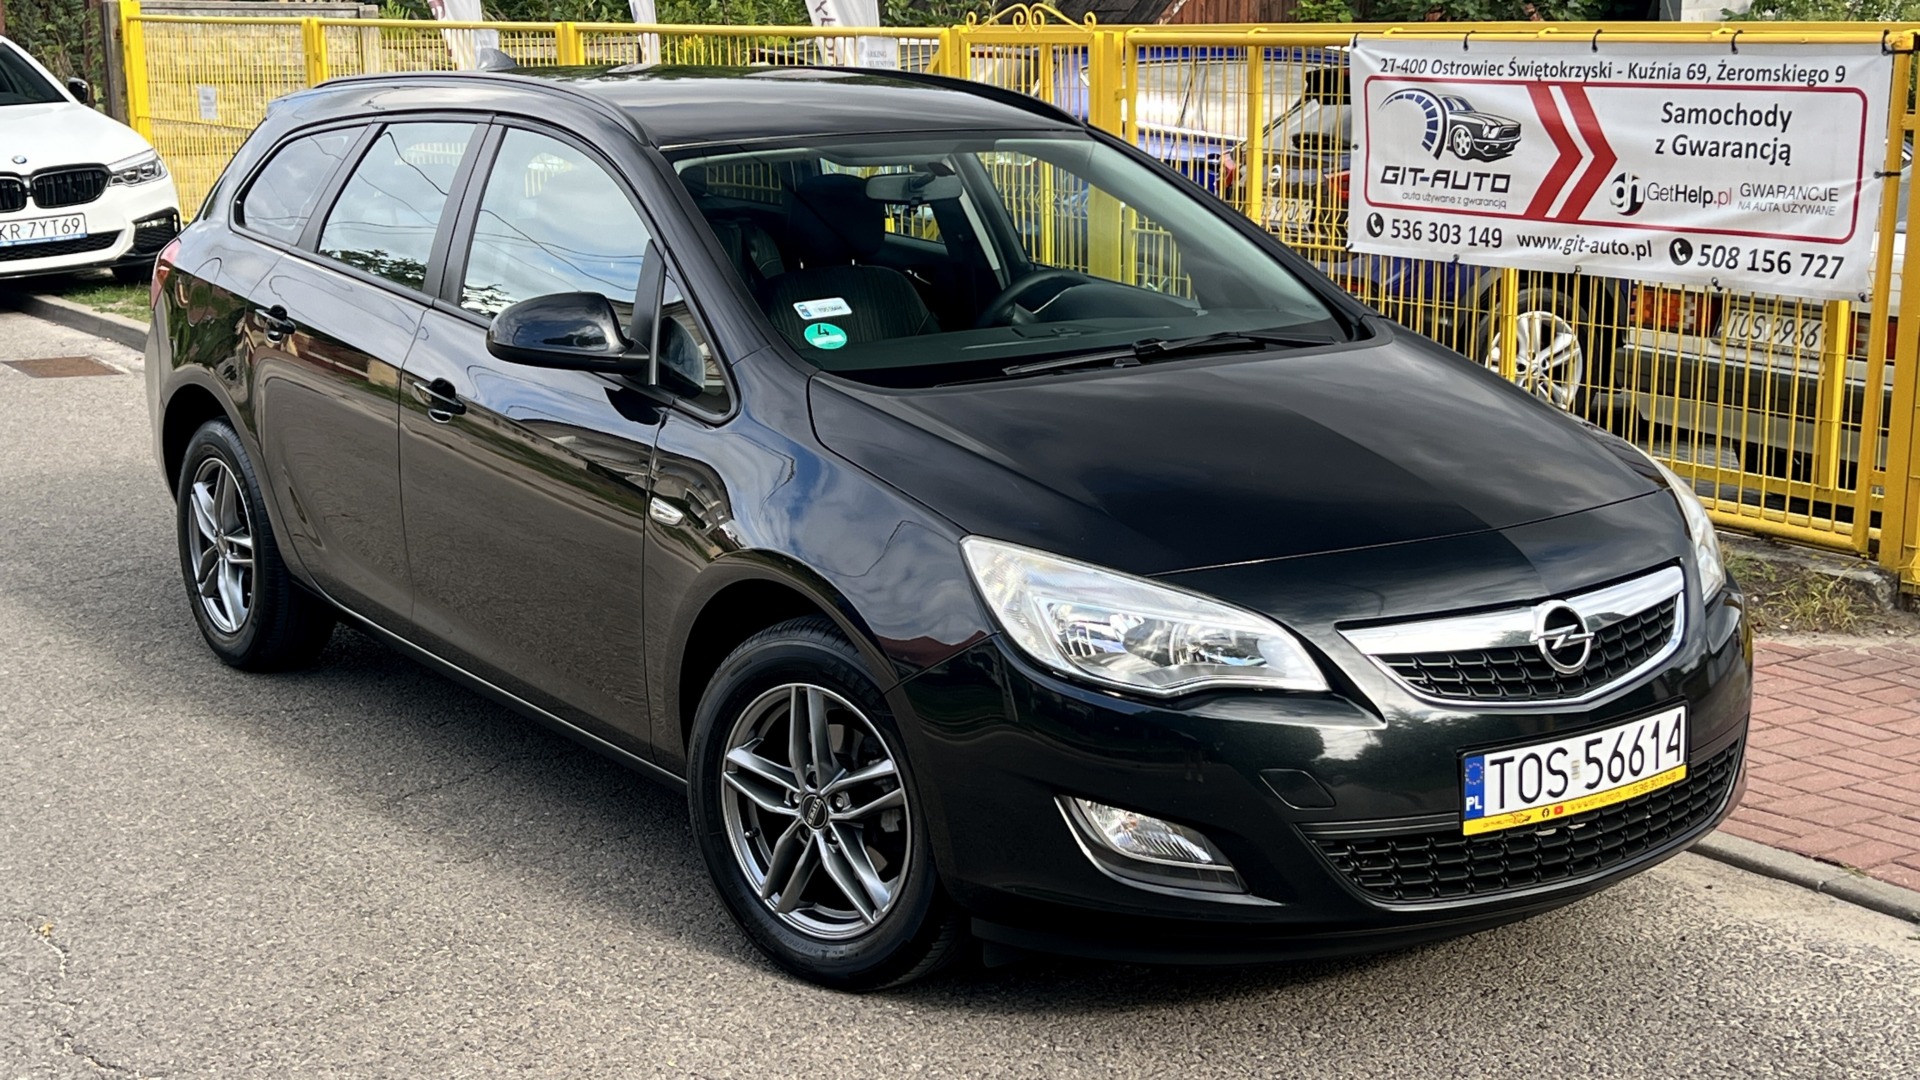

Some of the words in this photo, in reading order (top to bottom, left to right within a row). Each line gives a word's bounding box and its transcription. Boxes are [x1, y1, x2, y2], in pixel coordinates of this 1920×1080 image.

[1380, 58, 1427, 74] 27-400
[1431, 59, 1504, 77] Ostrowiec
[1508, 57, 1612, 82] Świętokrzyski
[1627, 61, 1681, 80] Kuźnia
[1686, 62, 1711, 83] 69,
[1717, 59, 1829, 87] Żeromskiego
[1834, 65, 1846, 84] 9
[1661, 101, 1792, 133] Samochody
[1654, 138, 1665, 154] z
[1672, 134, 1791, 166] Gwarancją
[1380, 165, 1511, 193] GIT-AUTO
[1739, 183, 1839, 202] GWARANCJE
[1402, 191, 1420, 200] auta
[1463, 197, 1506, 209] gwarancją
[1647, 182, 1732, 208] GetHelp.pl
[1737, 202, 1751, 210] NA
[1752, 202, 1779, 213] AUTA
[1782, 202, 1835, 216] UŻYWANE
[27, 217, 80, 238] 7YT69
[1391, 218, 1422, 241] 536
[1428, 222, 1461, 245] 303
[1468, 226, 1502, 248] 149
[1517, 234, 1652, 260] www.git-auto.pl
[1697, 244, 1740, 269] 508
[1747, 249, 1791, 274] 156
[1800, 253, 1845, 280] 727
[1729, 312, 1766, 339] TOS
[1489, 746, 1569, 810] TOS
[1584, 712, 1683, 790] 56614
[1466, 795, 1483, 812] PL
